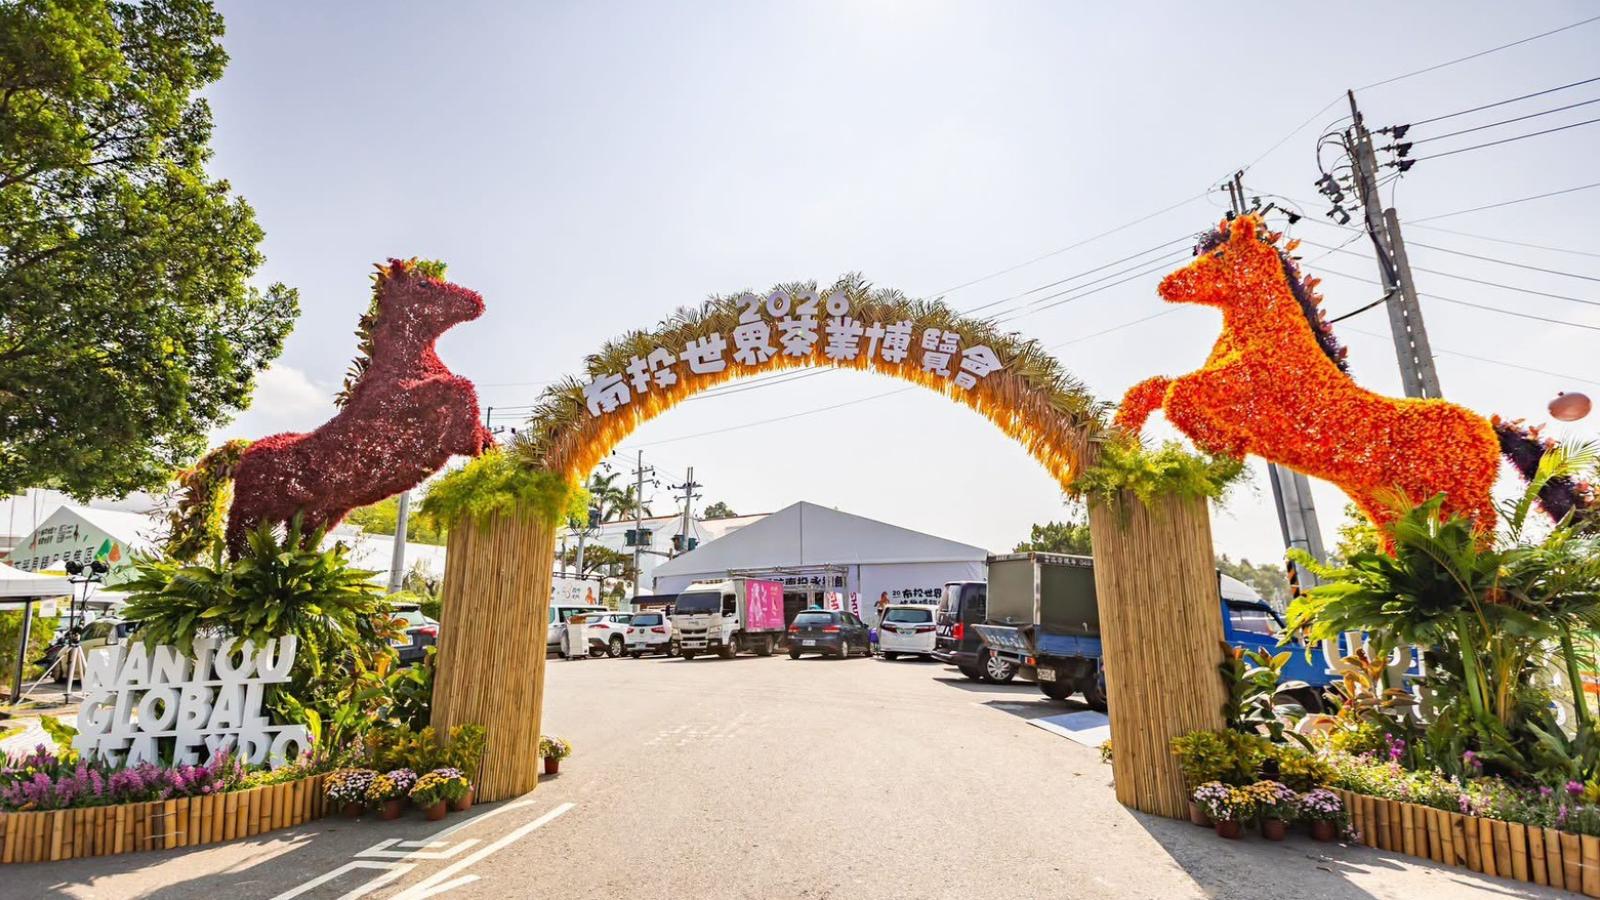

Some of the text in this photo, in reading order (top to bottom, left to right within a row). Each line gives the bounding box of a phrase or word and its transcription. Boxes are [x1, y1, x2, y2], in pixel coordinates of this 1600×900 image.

[735, 290, 851, 322] 2026
[582, 314, 1003, 418] 南投世界茶業博覽會
[82, 635, 297, 692] NANTOU
[77, 683, 269, 735] GLOBAL
[71, 726, 309, 772] TEA EXPO
